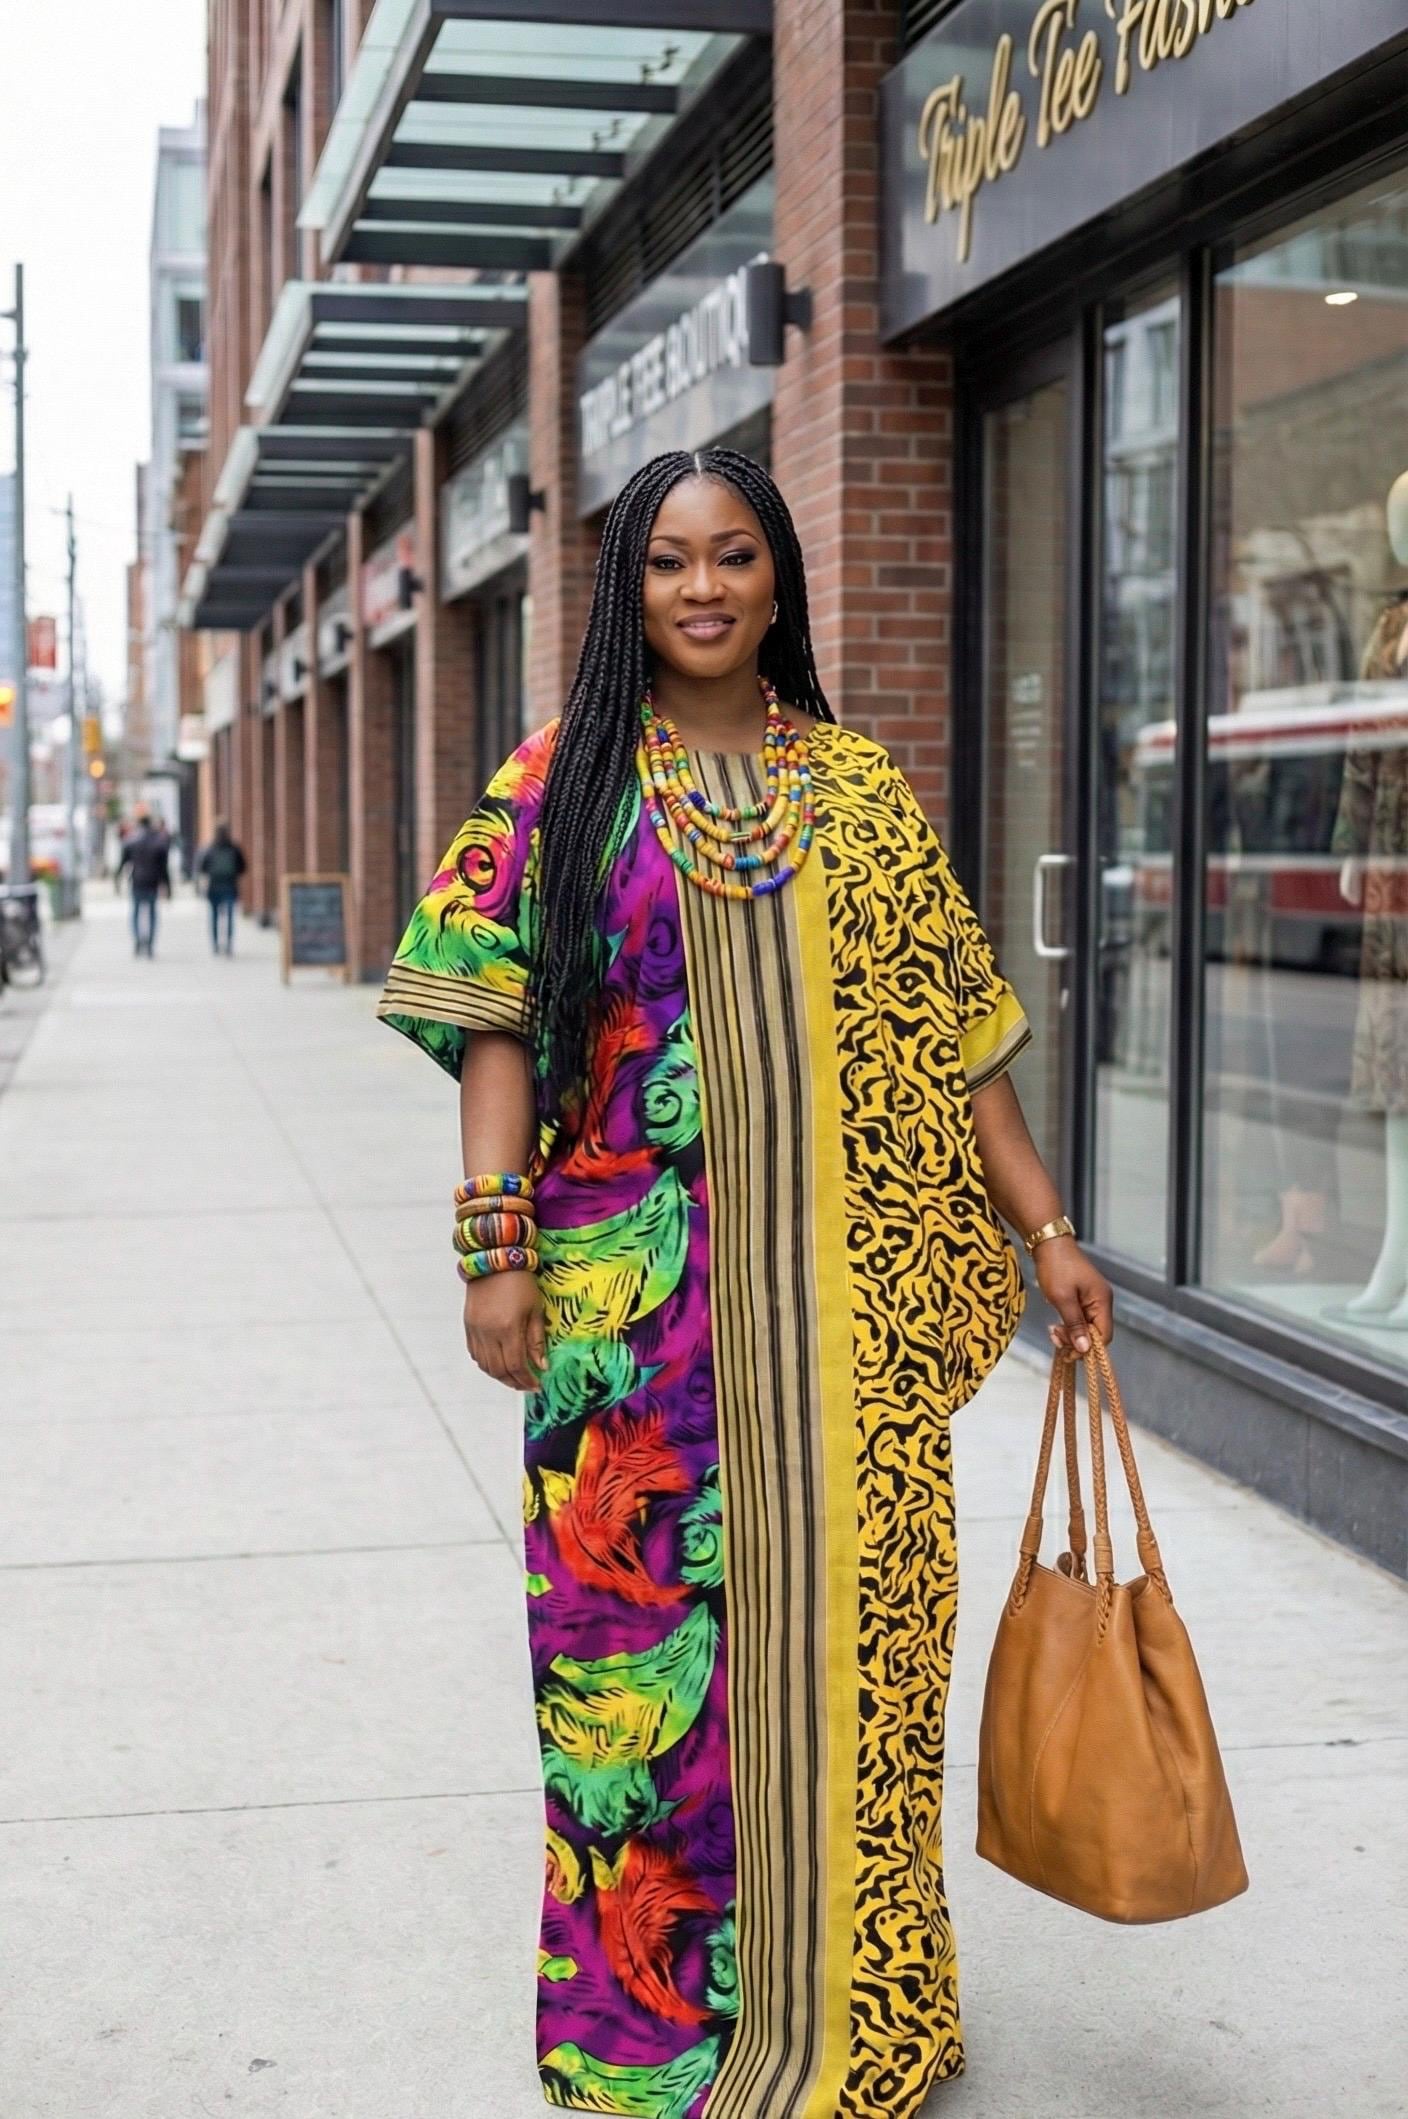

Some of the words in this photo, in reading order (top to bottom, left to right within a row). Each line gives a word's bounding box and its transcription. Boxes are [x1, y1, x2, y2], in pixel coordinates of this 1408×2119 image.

[918, 32, 1027, 264] Triple
[1028, 0, 1102, 149] Tee
[1105, 0, 1250, 96] Fas
[665, 252, 769, 399] BOUTIQ
